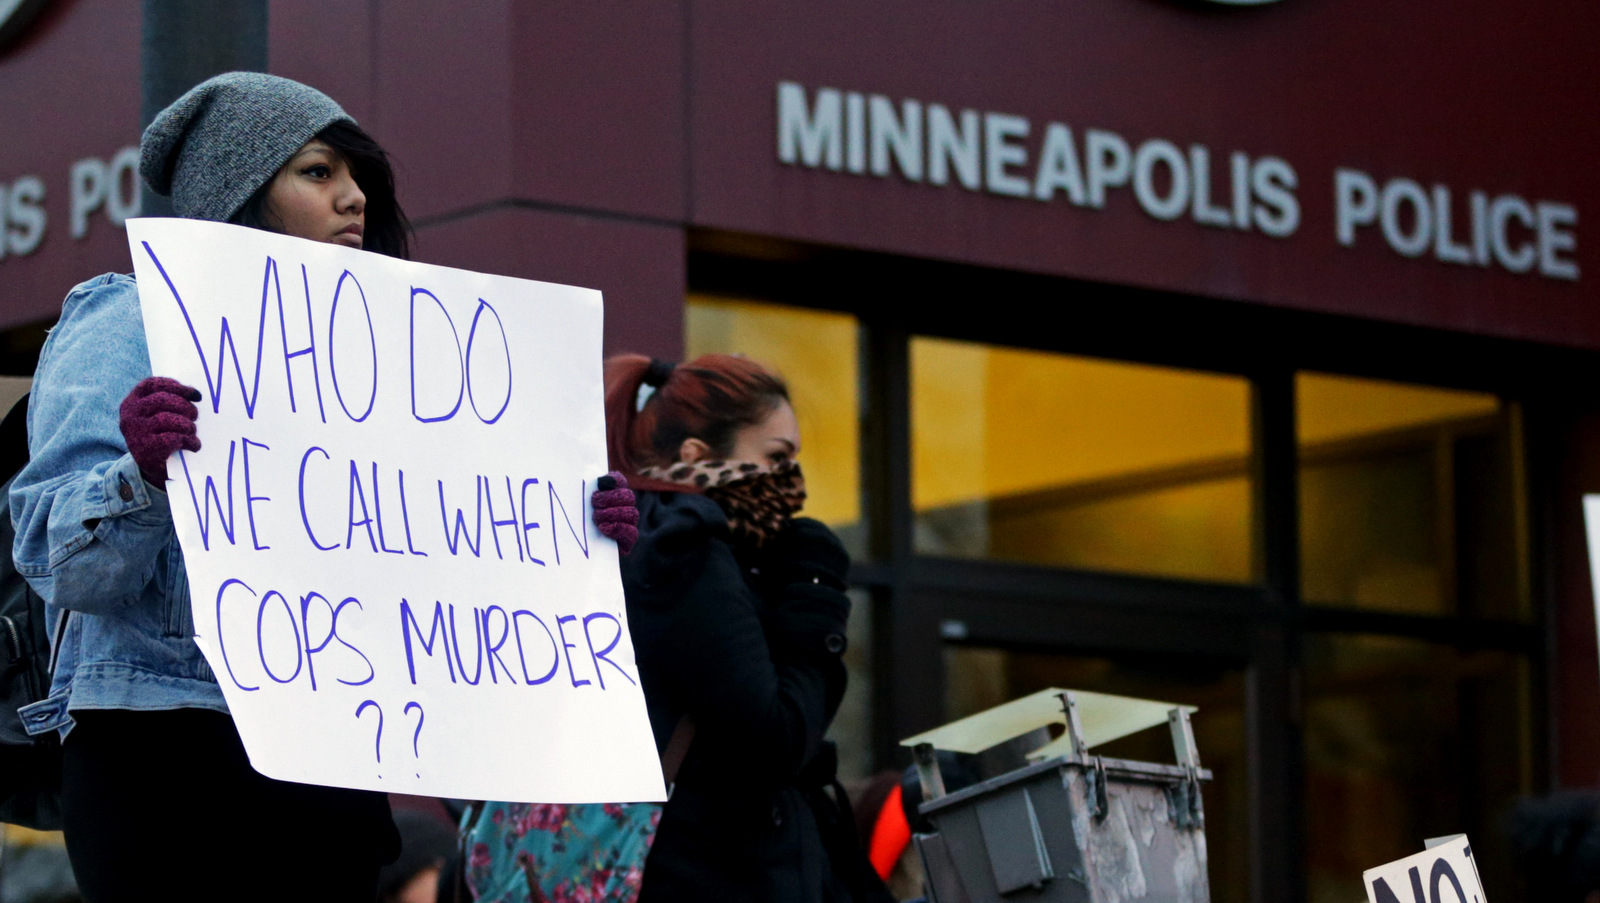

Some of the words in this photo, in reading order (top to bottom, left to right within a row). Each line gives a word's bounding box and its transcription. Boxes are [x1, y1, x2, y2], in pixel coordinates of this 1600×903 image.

[777, 81, 1300, 238] MINNEAPOLIS
[1335, 168, 1580, 280] POLICE
[141, 240, 377, 424] WHO
[410, 285, 512, 424] DO
[178, 436, 272, 552] WE
[298, 446, 429, 558] CALL
[437, 474, 590, 567] WHEN
[216, 577, 375, 692] COPS
[400, 597, 637, 691] MURDER
